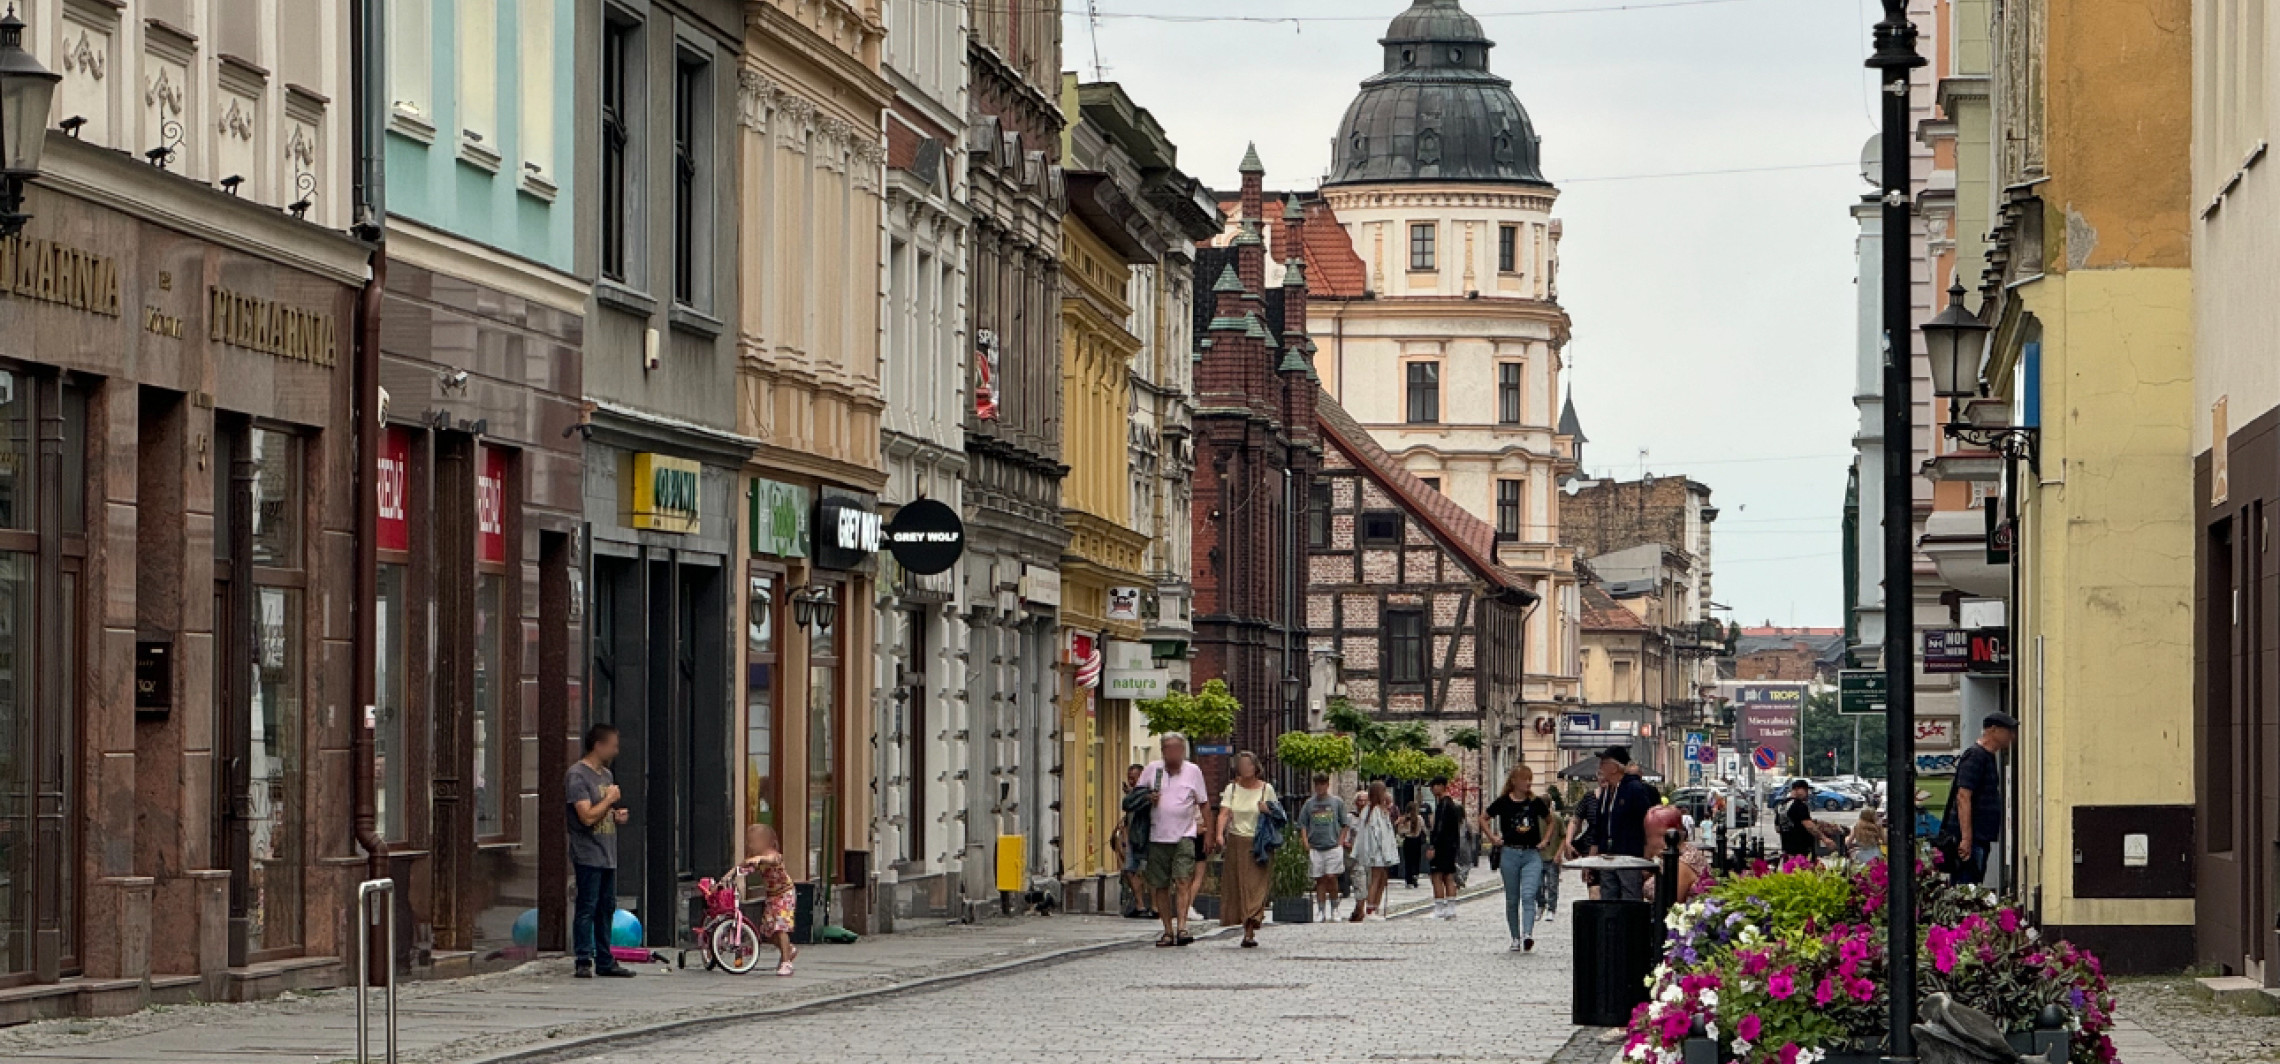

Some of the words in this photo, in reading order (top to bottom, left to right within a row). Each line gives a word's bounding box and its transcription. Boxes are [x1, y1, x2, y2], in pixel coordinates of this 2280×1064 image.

[210, 286, 336, 368] PIEKARNIA
[838, 506, 861, 550] GREY
[893, 531, 925, 542] GREY
[926, 531, 959, 542] WOLF
[1112, 677, 1157, 689] natura
[1769, 690, 1800, 701] TROPS
[1687, 745, 1698, 757] P
